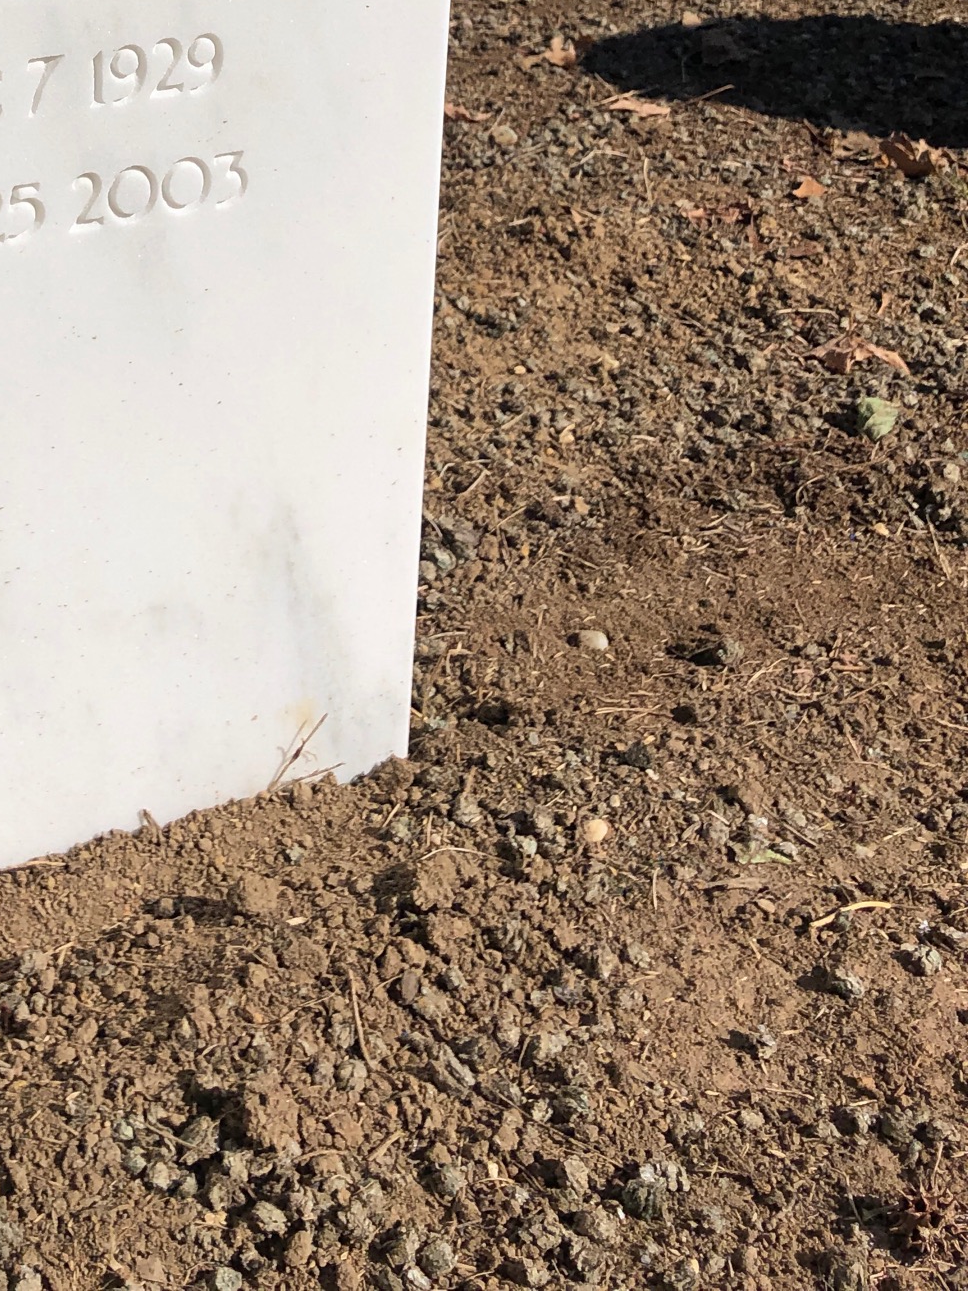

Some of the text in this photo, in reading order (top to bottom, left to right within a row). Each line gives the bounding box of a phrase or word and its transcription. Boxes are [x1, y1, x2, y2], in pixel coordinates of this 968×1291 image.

[27, 54, 65, 117] 7
[92, 32, 225, 105] 1929
[71, 150, 249, 226] 2003
